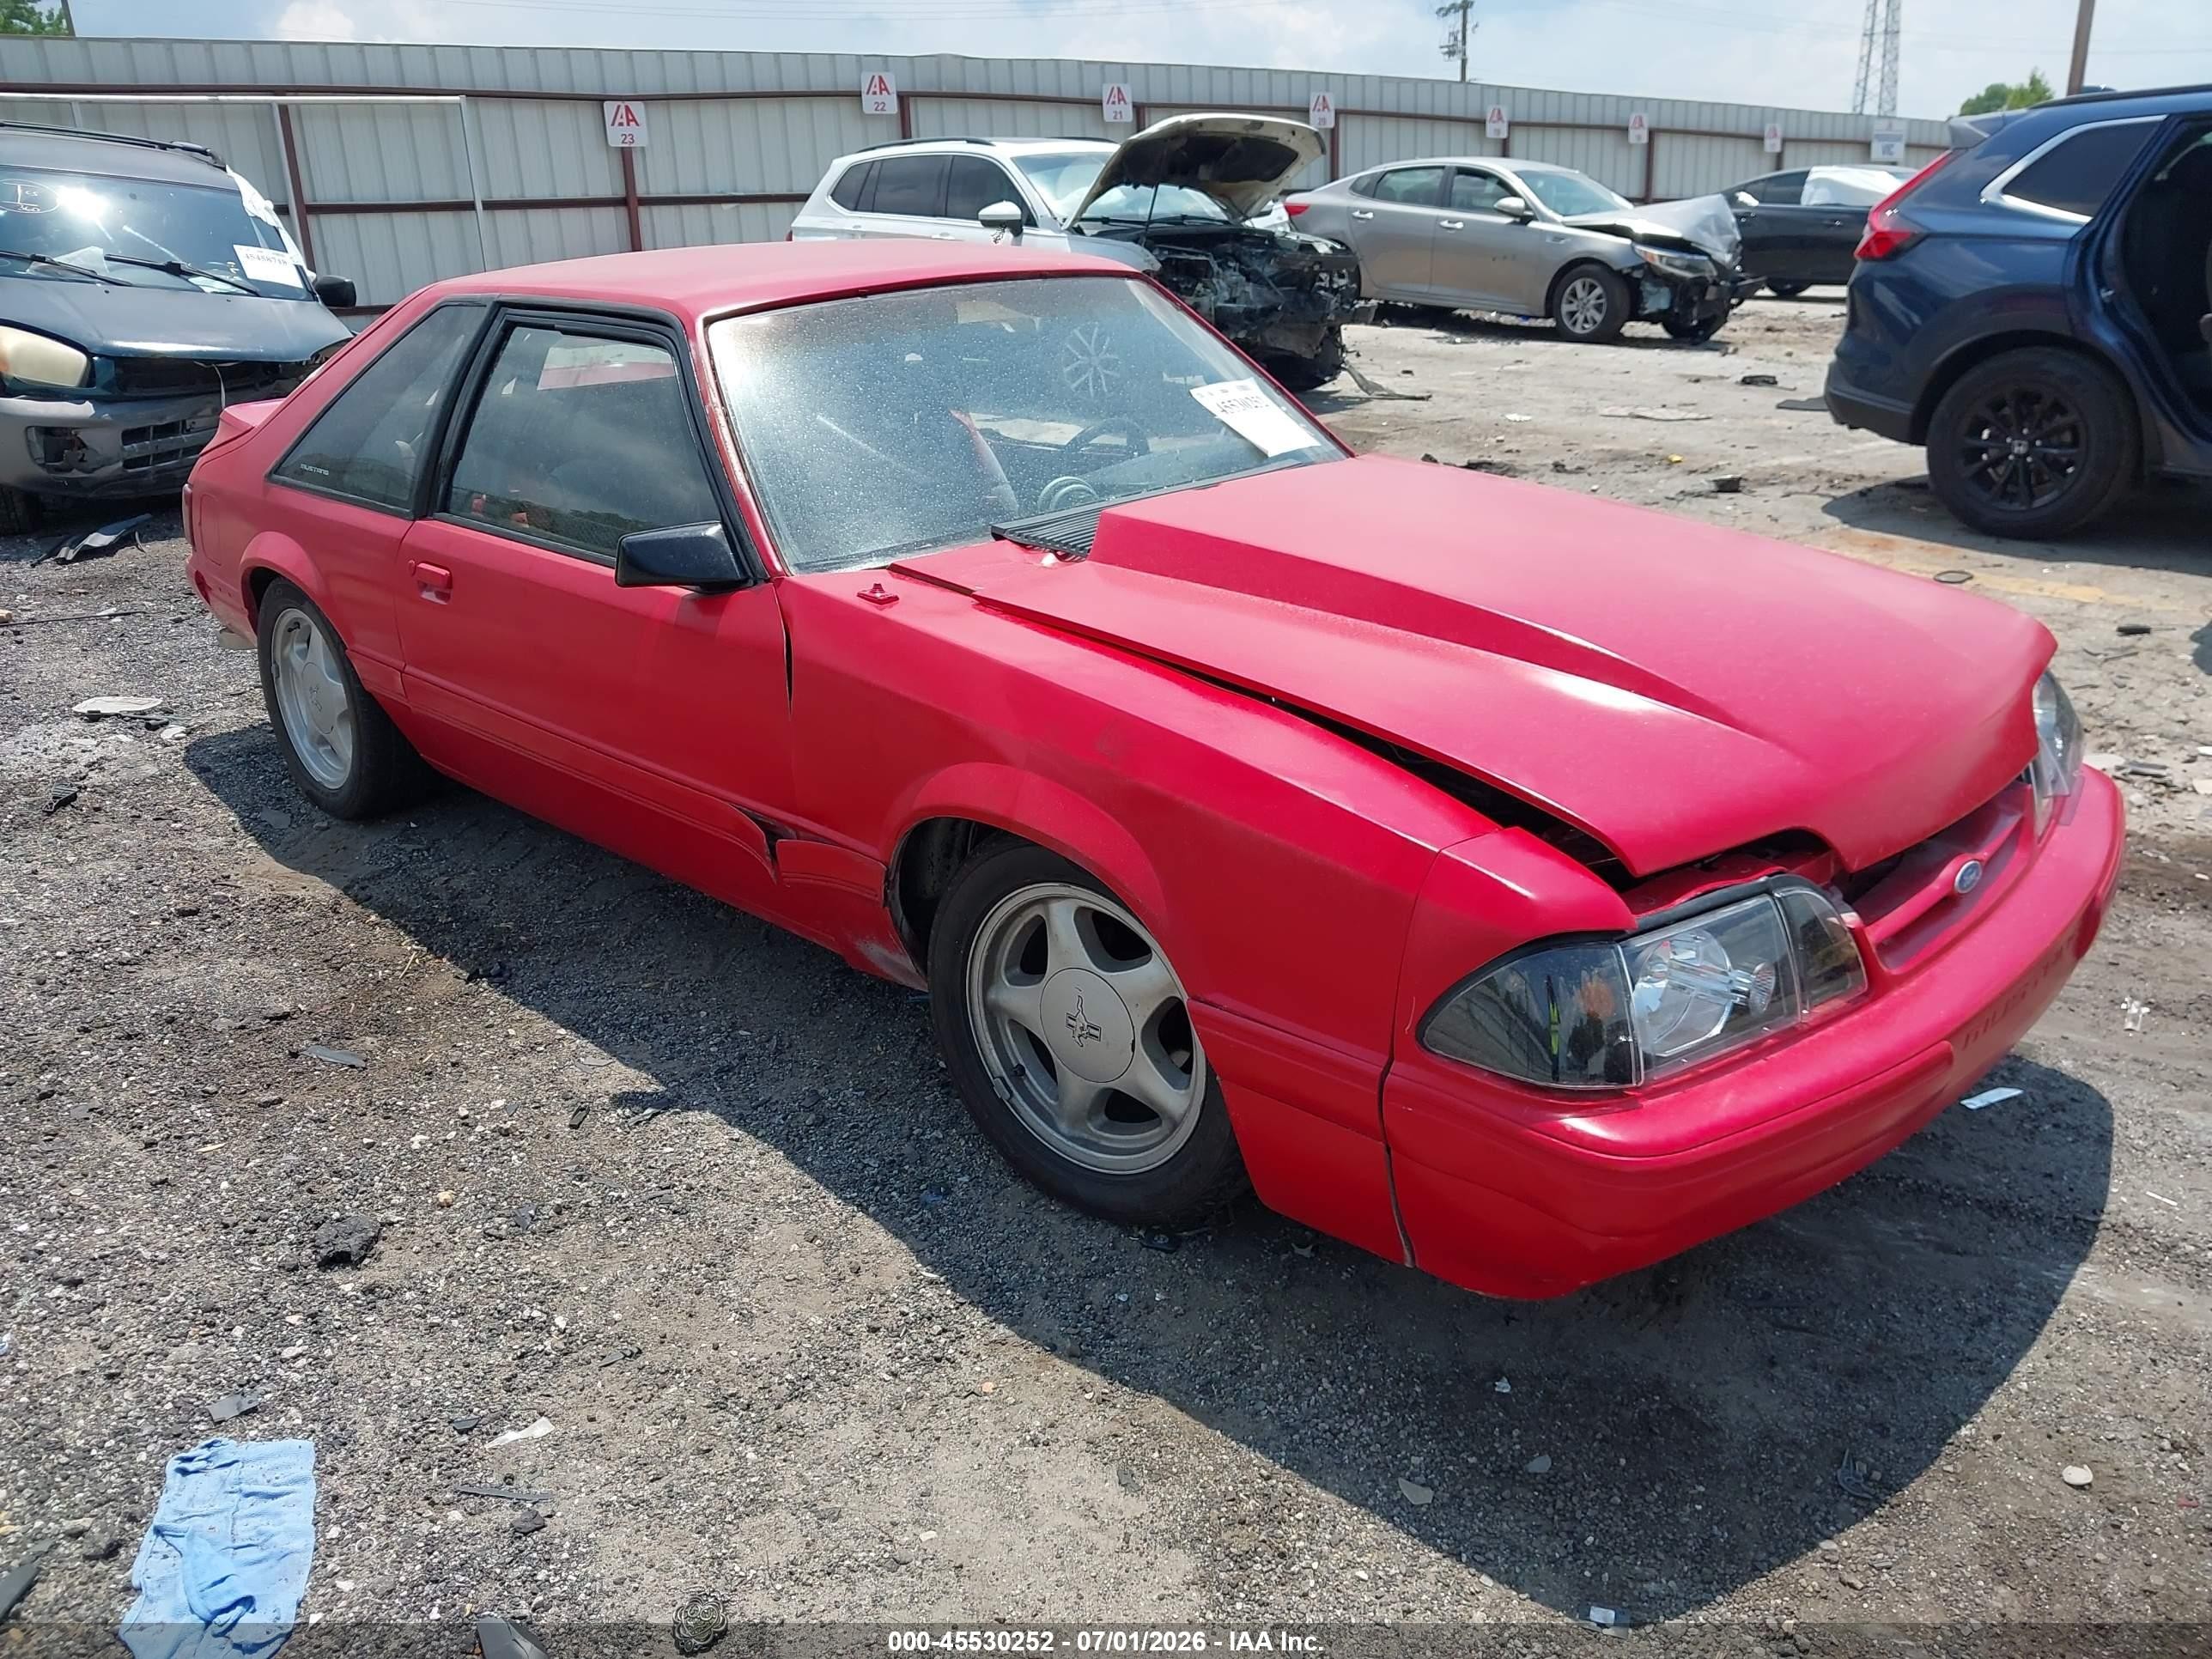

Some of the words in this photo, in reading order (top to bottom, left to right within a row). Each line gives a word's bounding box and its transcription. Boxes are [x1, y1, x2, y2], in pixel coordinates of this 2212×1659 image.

[873, 101, 887, 112] 22
[1112, 111, 1123, 120] 21
[620, 133, 635, 144] 23
